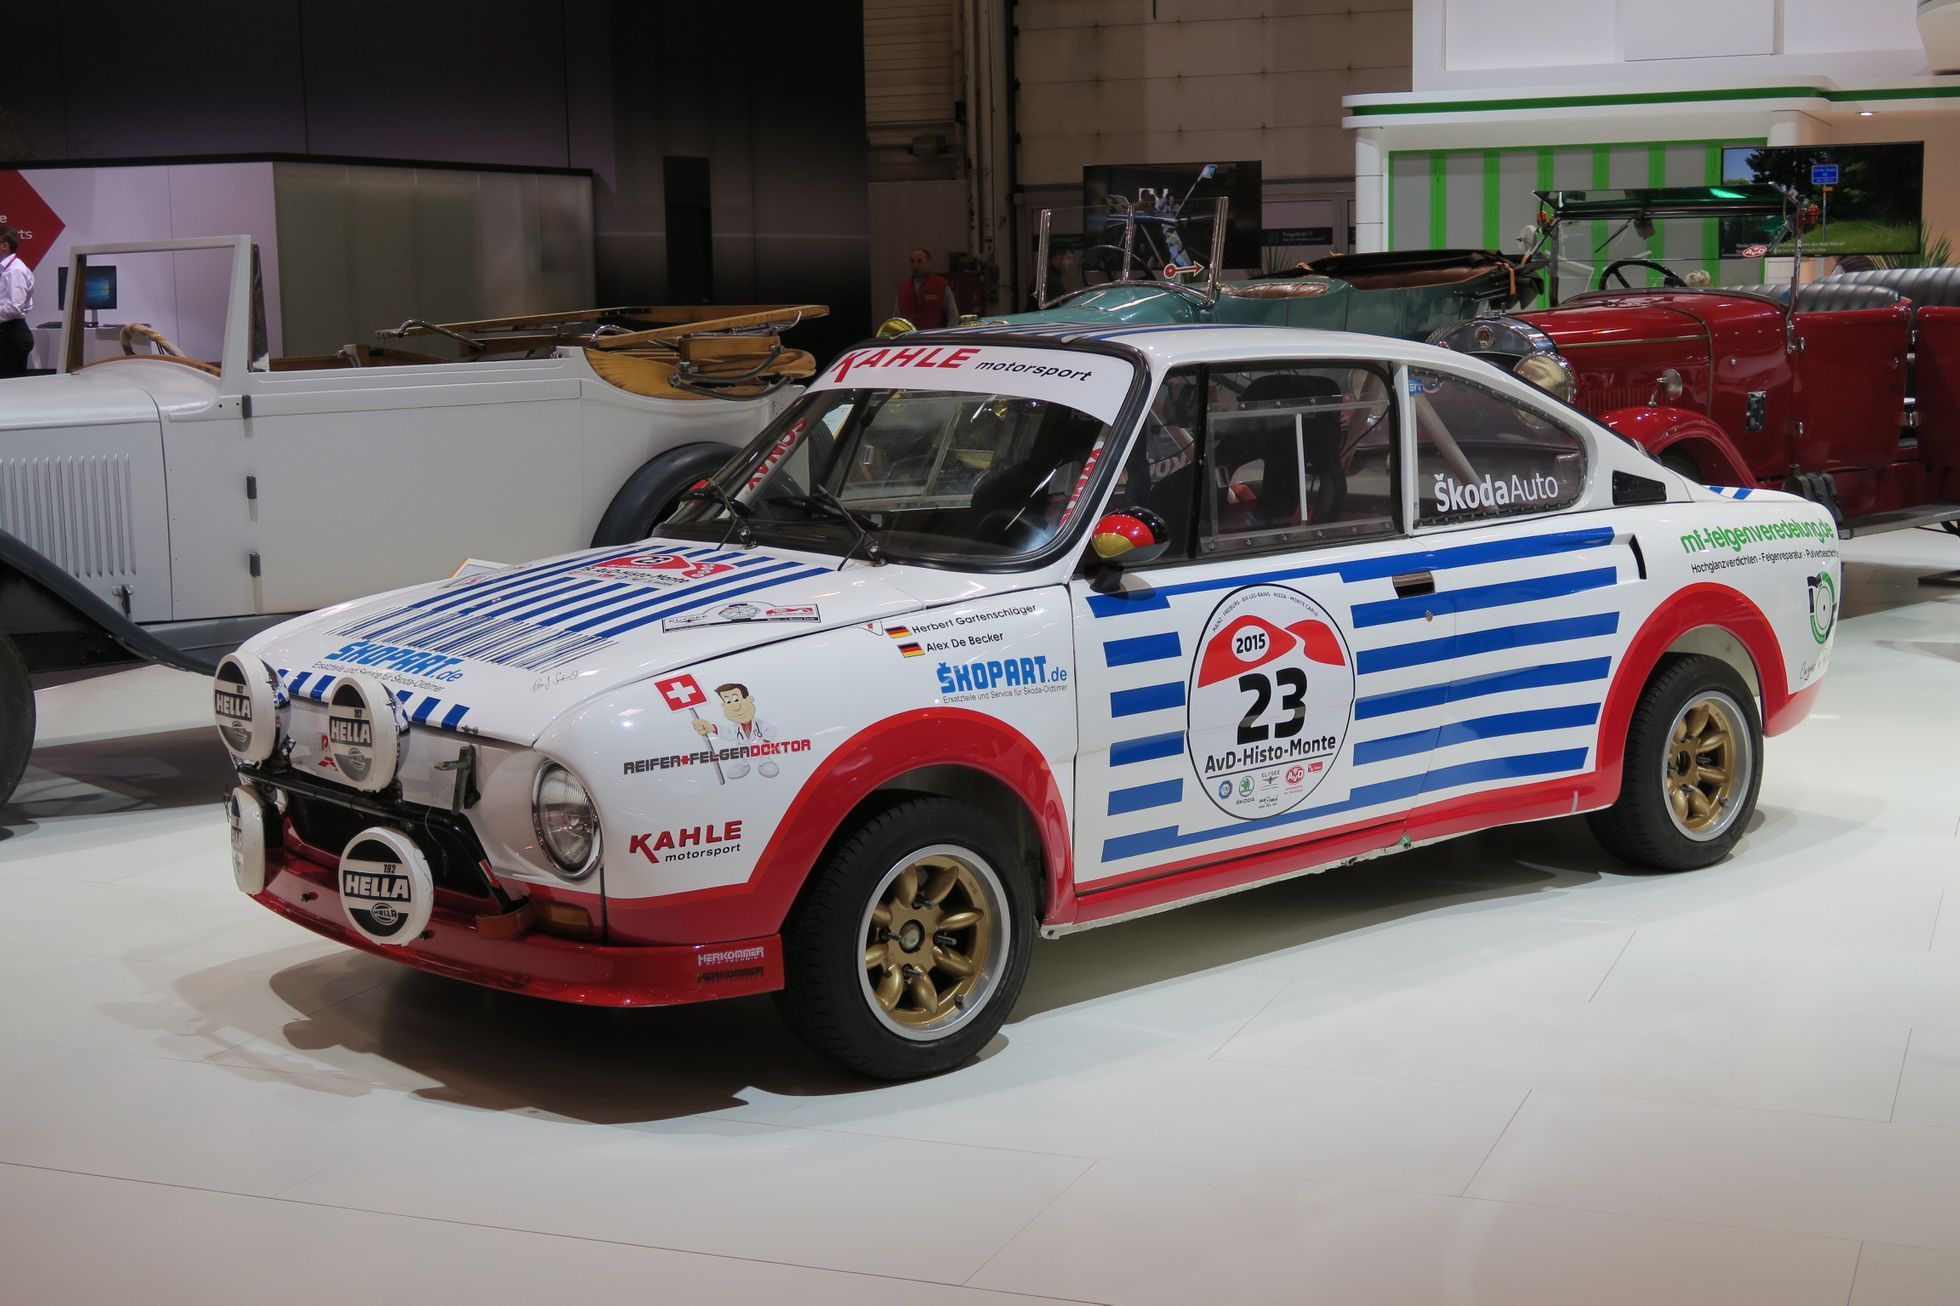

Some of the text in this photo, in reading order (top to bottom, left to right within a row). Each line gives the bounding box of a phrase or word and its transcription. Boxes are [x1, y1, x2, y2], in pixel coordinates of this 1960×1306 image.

[830, 348, 1093, 383] KAHLE motorsport
[1434, 473, 1559, 513] ŠkodaAuto
[912, 604, 1037, 634] Herbert Gartenschläger
[926, 632, 1005, 652] Alex De Becker
[1236, 633, 1266, 654] 2015
[936, 655, 1068, 694] ŠKOPART.de
[216, 693, 251, 719] HELLA
[943, 690, 976, 704] Ersatzteile
[977, 690, 990, 701] und
[990, 688, 1013, 699] Service
[1237, 667, 1308, 745] 23
[331, 720, 371, 744] HELLA
[1204, 735, 1336, 774] AvD-Histo-Monte
[1287, 769, 1304, 782] AvD
[629, 820, 743, 864] KAHLE
[665, 843, 741, 863] motorsport
[384, 864, 396, 873] 192
[345, 874, 409, 899] HELLA
[697, 946, 764, 966] HERKOMMER
